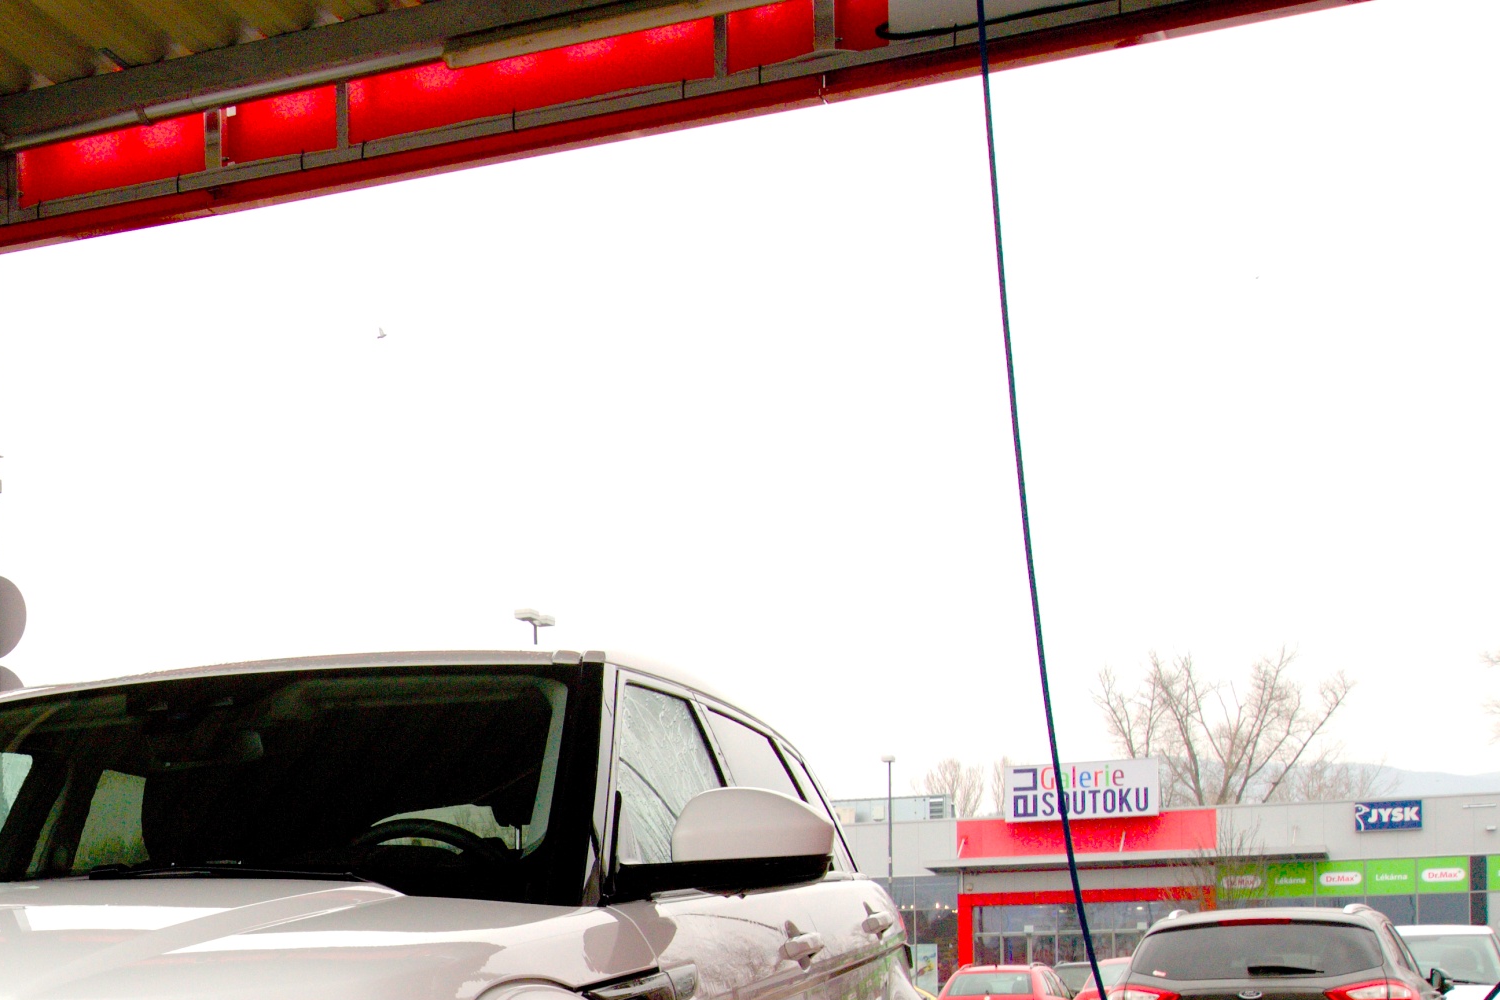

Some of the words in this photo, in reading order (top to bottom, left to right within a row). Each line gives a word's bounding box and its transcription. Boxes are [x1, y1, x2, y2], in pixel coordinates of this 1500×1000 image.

[1040, 764, 1125, 791] Galerie
[1041, 786, 1149, 817] SOUTOKU
[1367, 806, 1420, 824] JYSK
